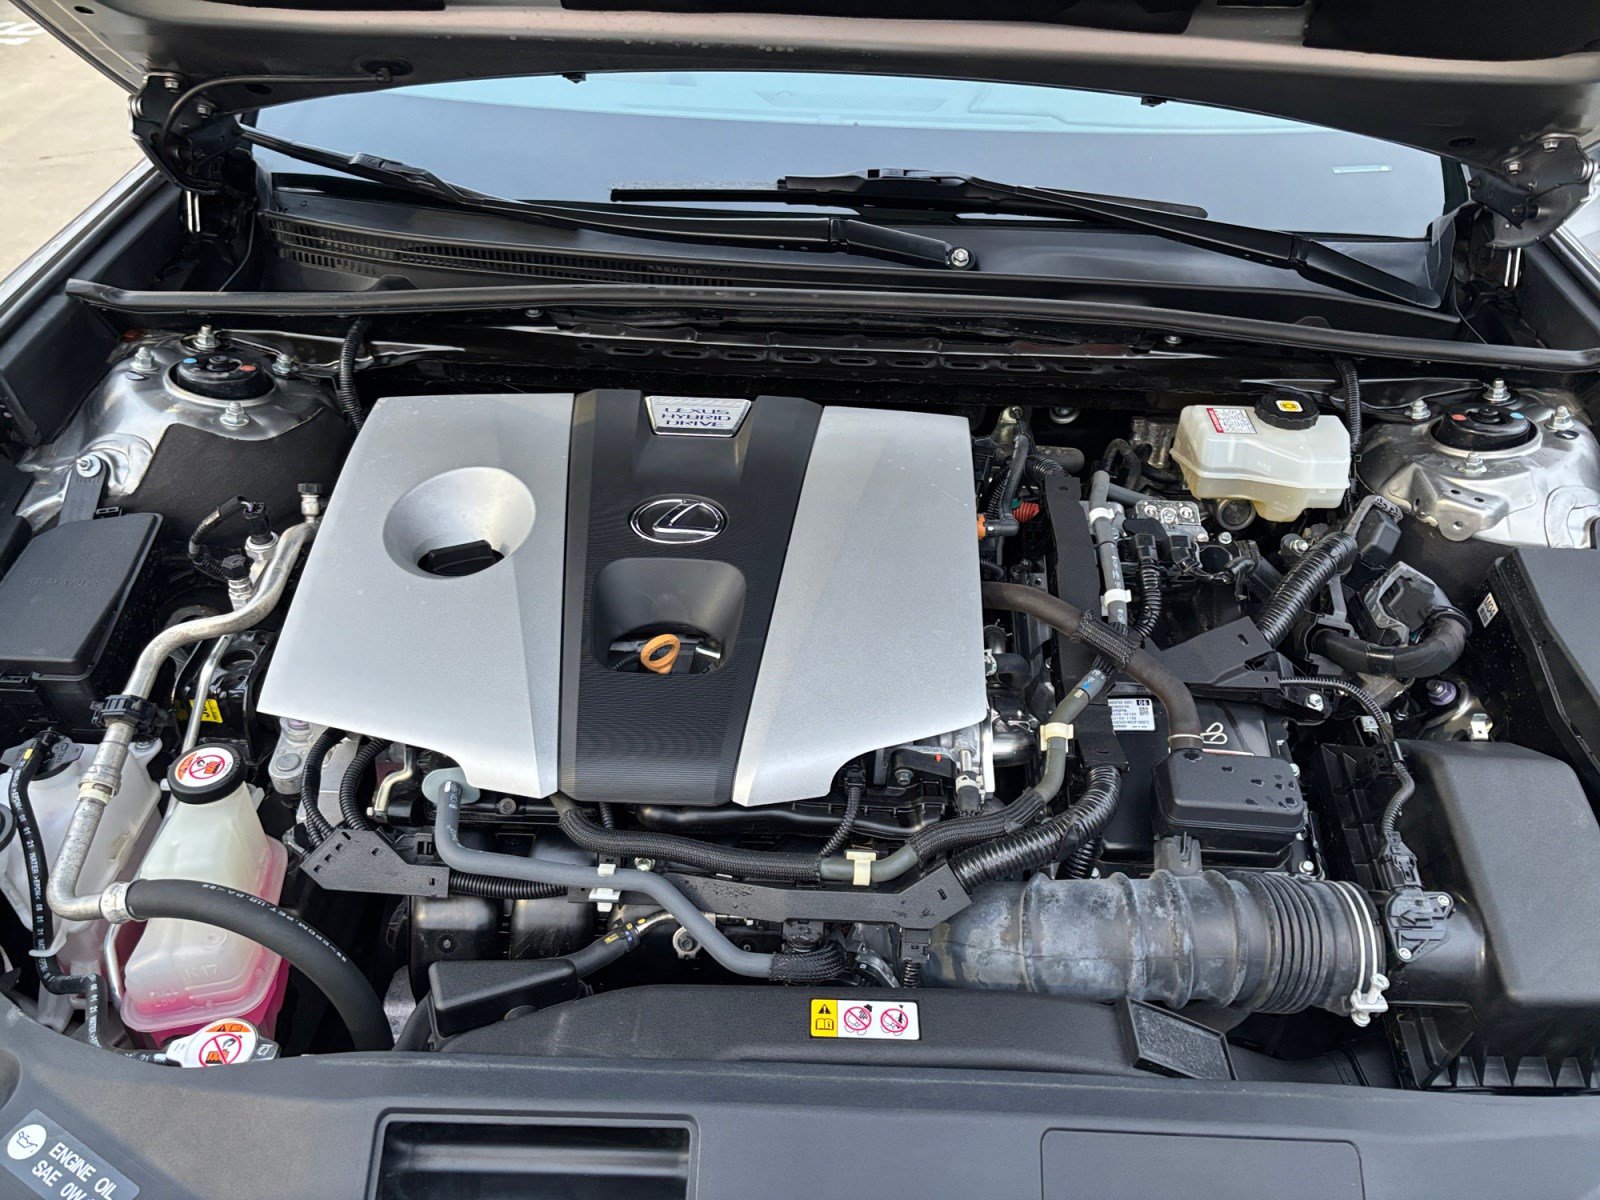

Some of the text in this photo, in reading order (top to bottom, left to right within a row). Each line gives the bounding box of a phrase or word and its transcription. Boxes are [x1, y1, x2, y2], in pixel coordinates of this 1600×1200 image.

[661, 413, 731, 421] HYBRID
[29, 852, 39, 874] WATER
[32, 1160, 63, 1187] SAE
[48, 1142, 117, 1200] ENGINE OIL
